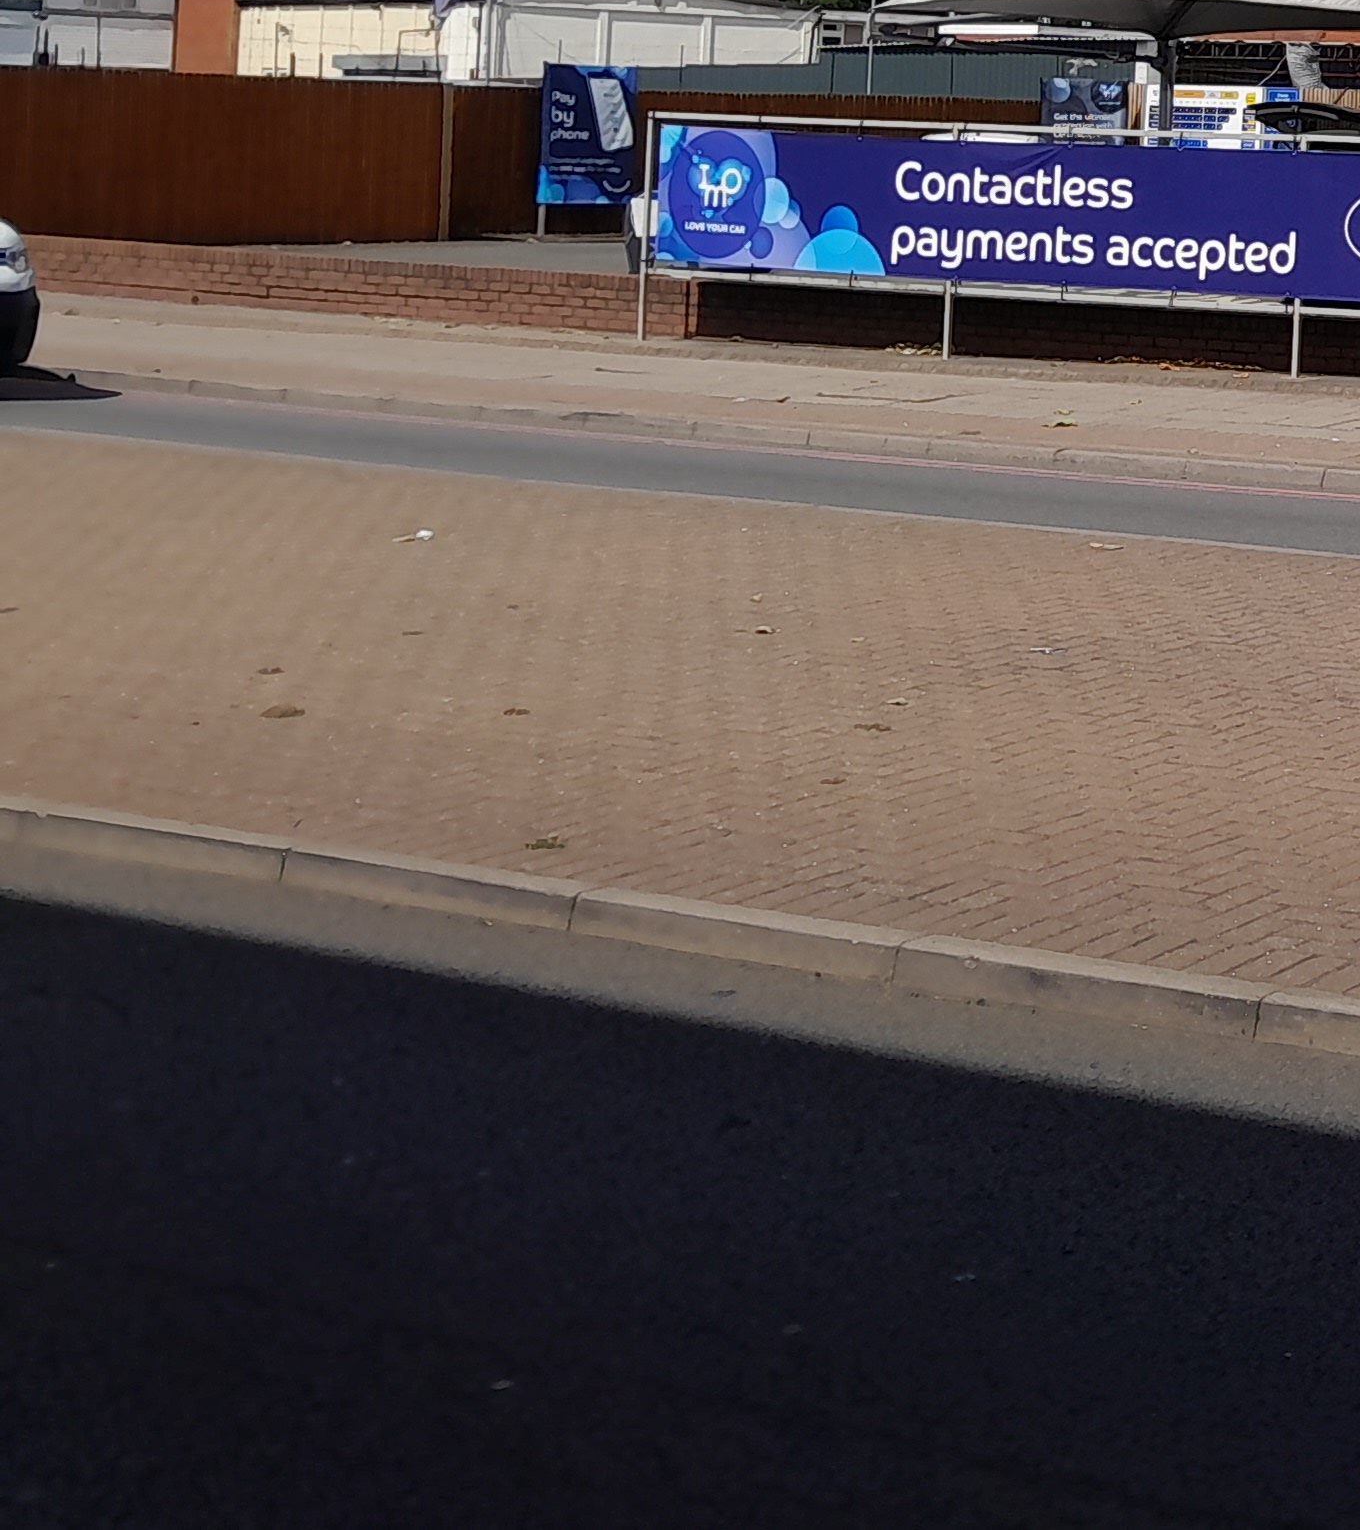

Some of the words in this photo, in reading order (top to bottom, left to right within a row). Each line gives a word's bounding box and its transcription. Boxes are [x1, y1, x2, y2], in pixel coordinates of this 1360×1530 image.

[552, 91, 576, 106] Pay
[551, 106, 575, 127] by
[550, 128, 590, 142] phone
[895, 160, 1134, 210] Contactless
[684, 221, 705, 231] LOVE
[706, 223, 729, 233] YOUR
[729, 224, 746, 234] CAR
[890, 225, 1095, 269] payments
[1106, 231, 1297, 281] accepted
